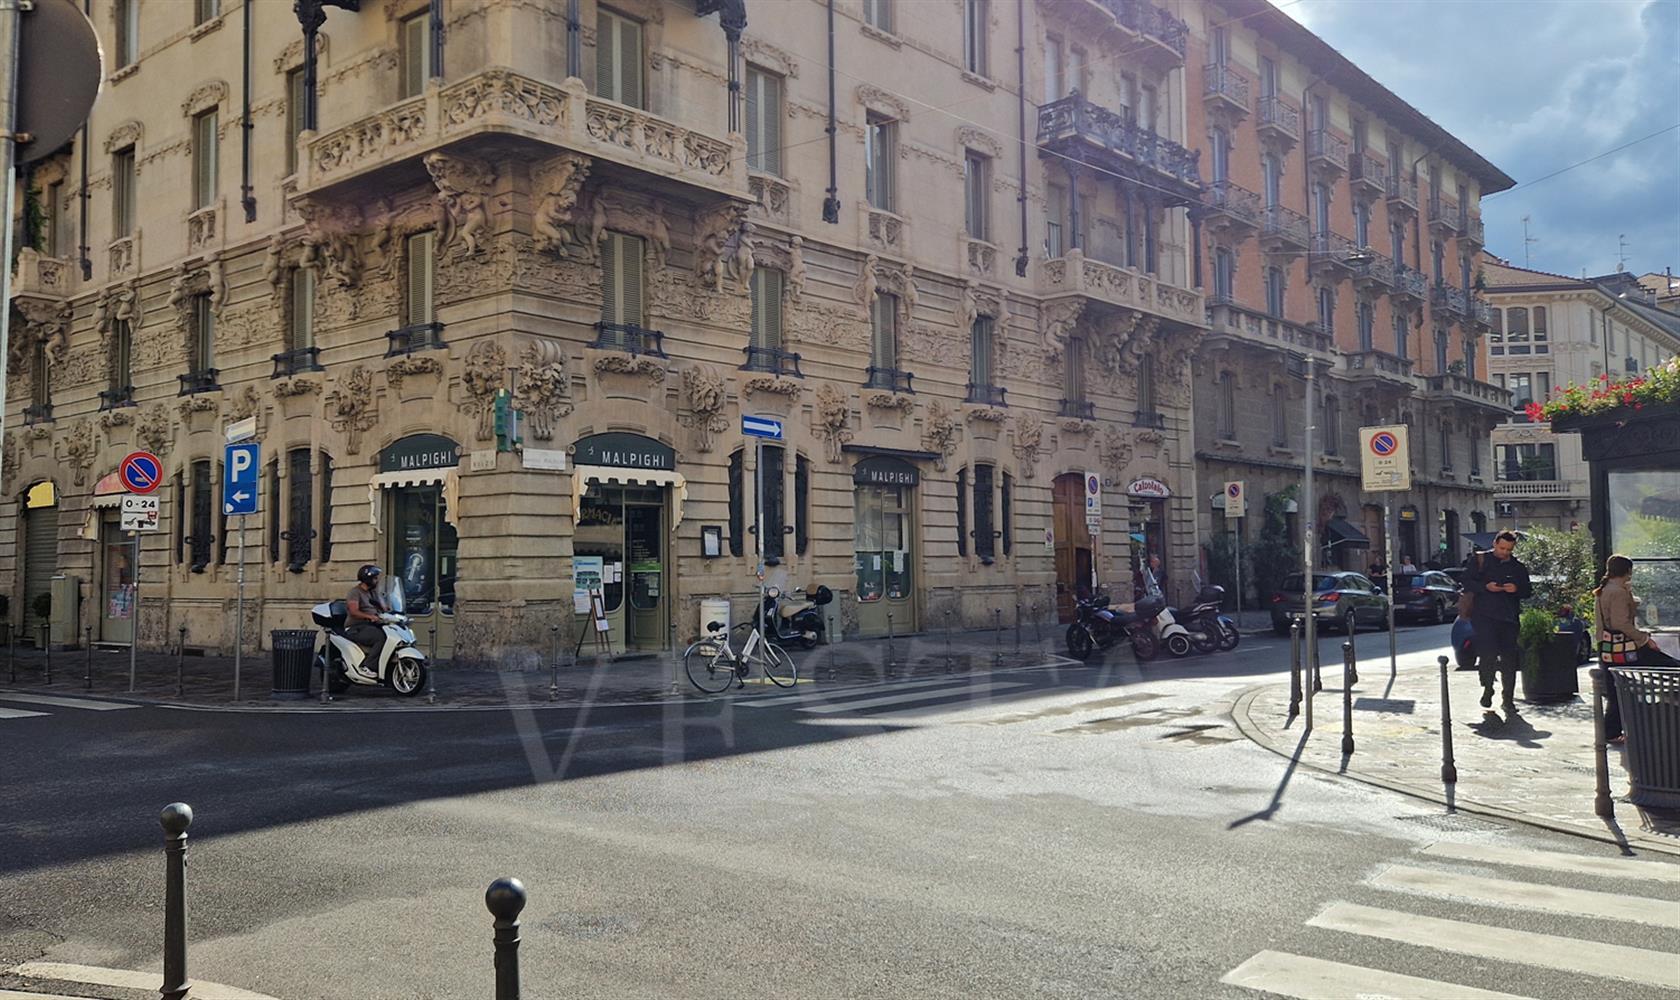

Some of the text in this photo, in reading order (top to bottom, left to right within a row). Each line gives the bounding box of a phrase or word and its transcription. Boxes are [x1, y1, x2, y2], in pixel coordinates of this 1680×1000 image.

[231, 448, 252, 483] P
[401, 450, 452, 468] MALPIGHI
[602, 450, 665, 467] MALPIGHI
[871, 470, 913, 484] MALPIGHI
